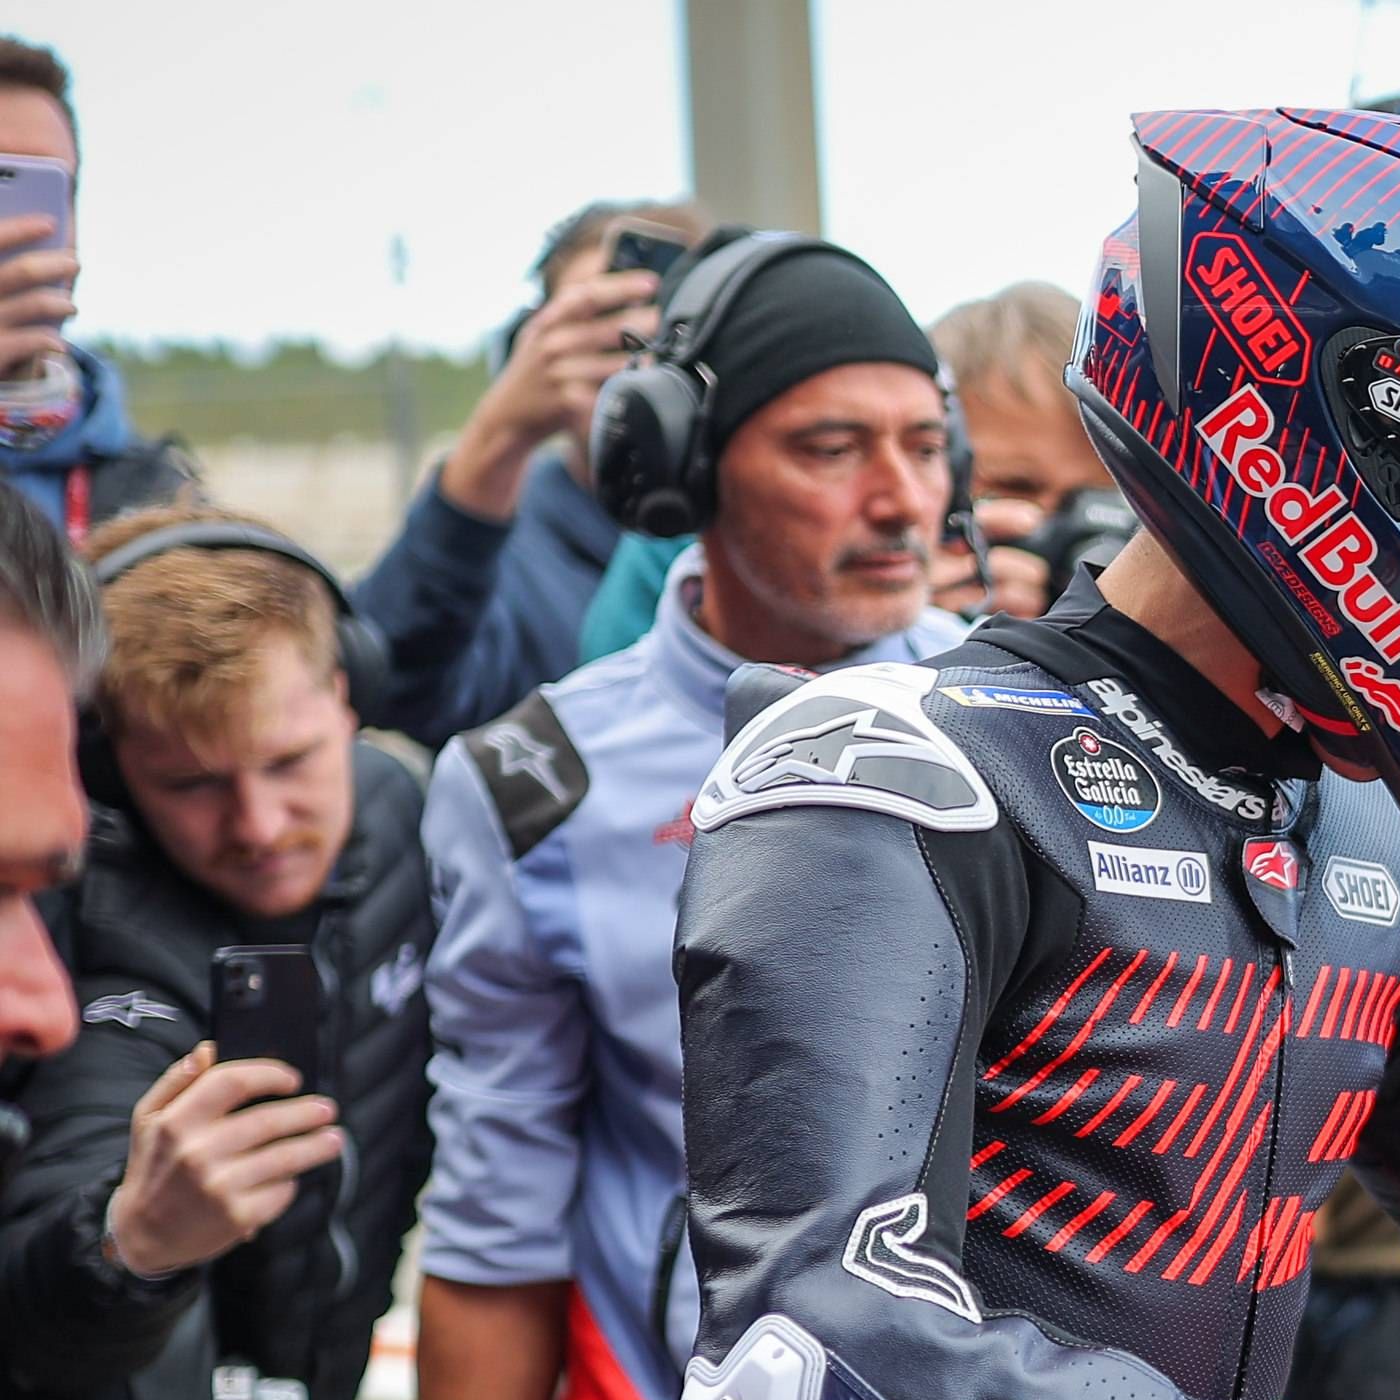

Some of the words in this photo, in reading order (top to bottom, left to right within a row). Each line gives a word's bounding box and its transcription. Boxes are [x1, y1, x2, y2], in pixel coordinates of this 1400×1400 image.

[1196, 246, 1300, 372] SHOEI
[992, 692, 1084, 710] MICHELIN
[1087, 677, 1266, 820] alpinestars
[1063, 754, 1138, 782] Estrella
[1074, 777, 1141, 806] Galicia
[1096, 852, 1172, 886] Allianz
[1334, 871, 1390, 912] SHOEI
